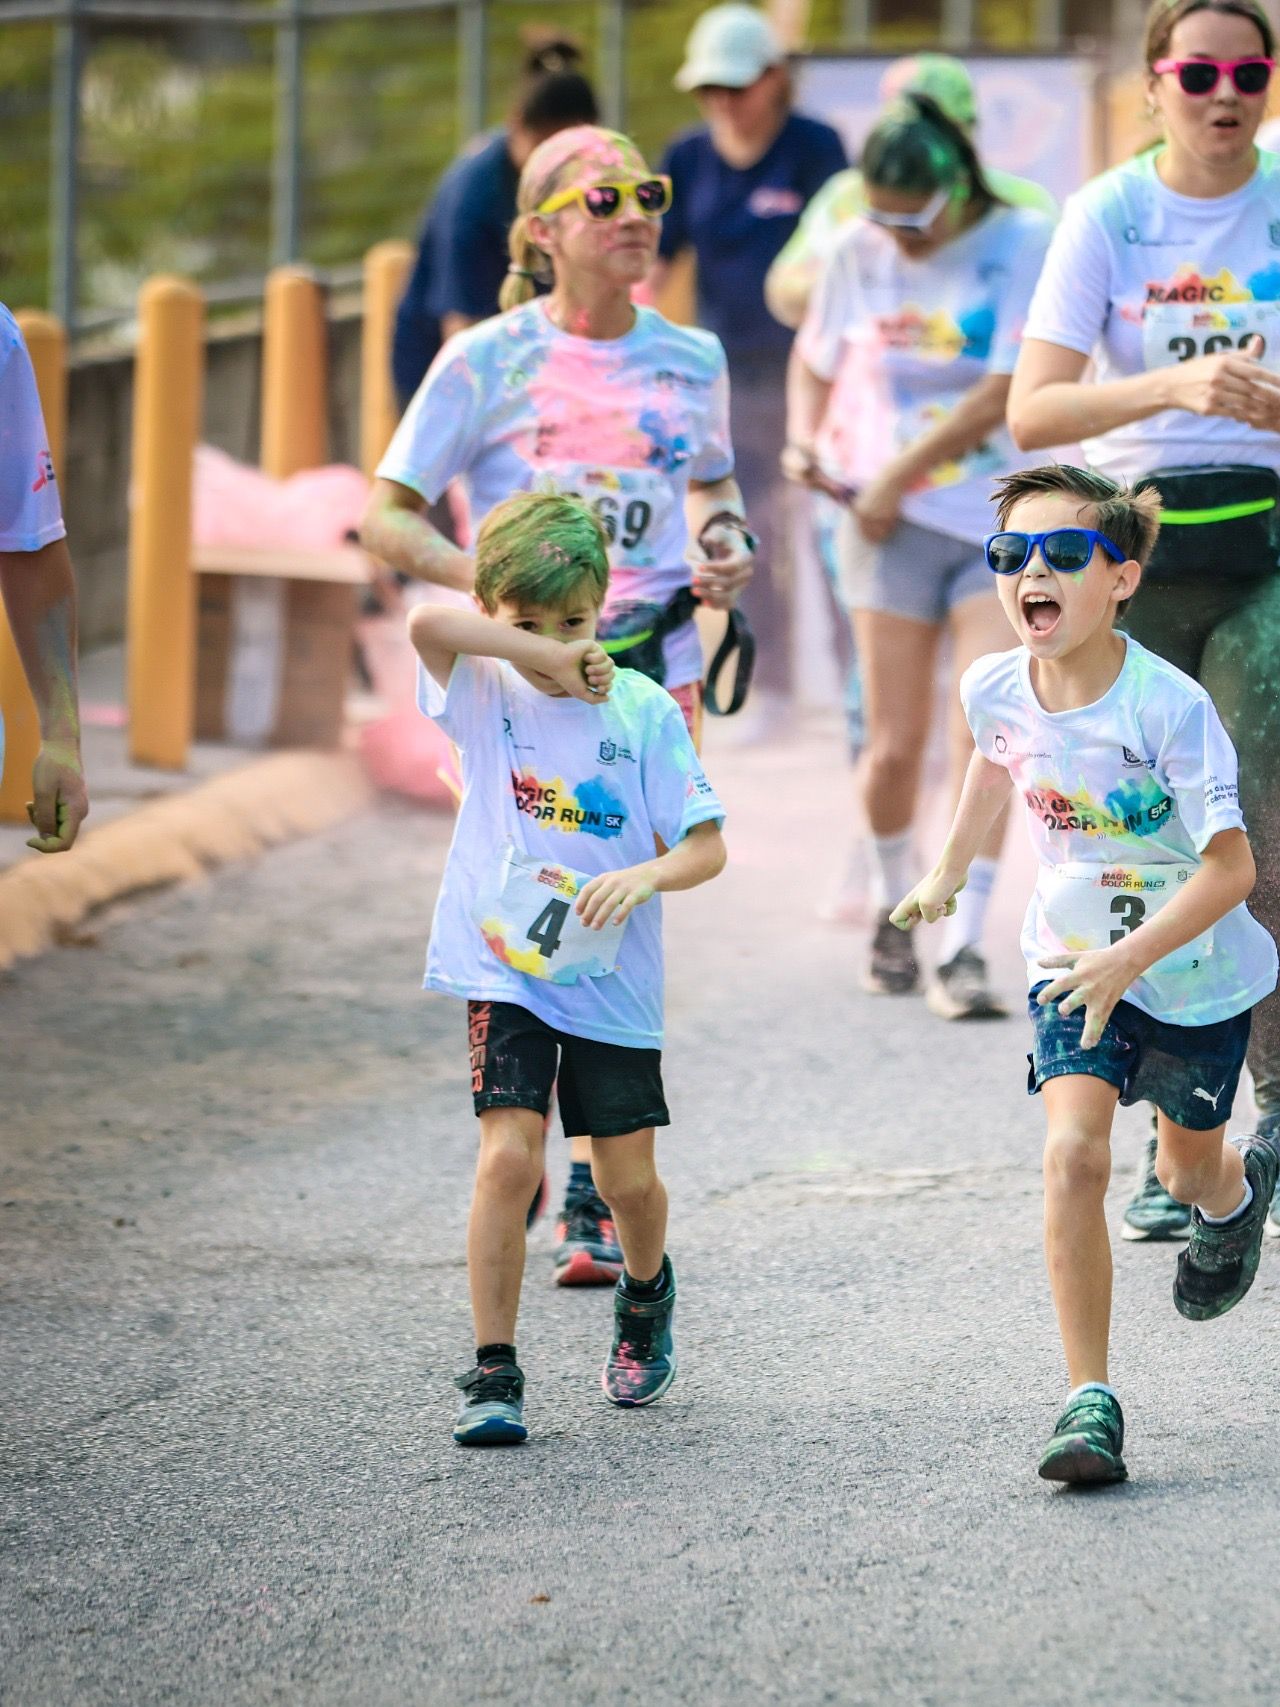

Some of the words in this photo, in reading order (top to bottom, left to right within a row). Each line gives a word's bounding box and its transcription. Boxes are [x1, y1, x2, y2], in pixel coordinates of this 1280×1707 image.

[560, 808, 602, 827] RUN
[605, 815, 622, 828] 5K
[1043, 814, 1098, 831] OLOR
[1150, 798, 1170, 820] 5K
[540, 867, 569, 884] MAGIC
[1101, 880, 1132, 888] COLOR
[1133, 880, 1153, 888] RUN
[1102, 873, 1133, 881] MAGIC
[526, 897, 571, 959] 4
[1109, 894, 1146, 947] 3
[1192, 959, 1199, 969] 3
